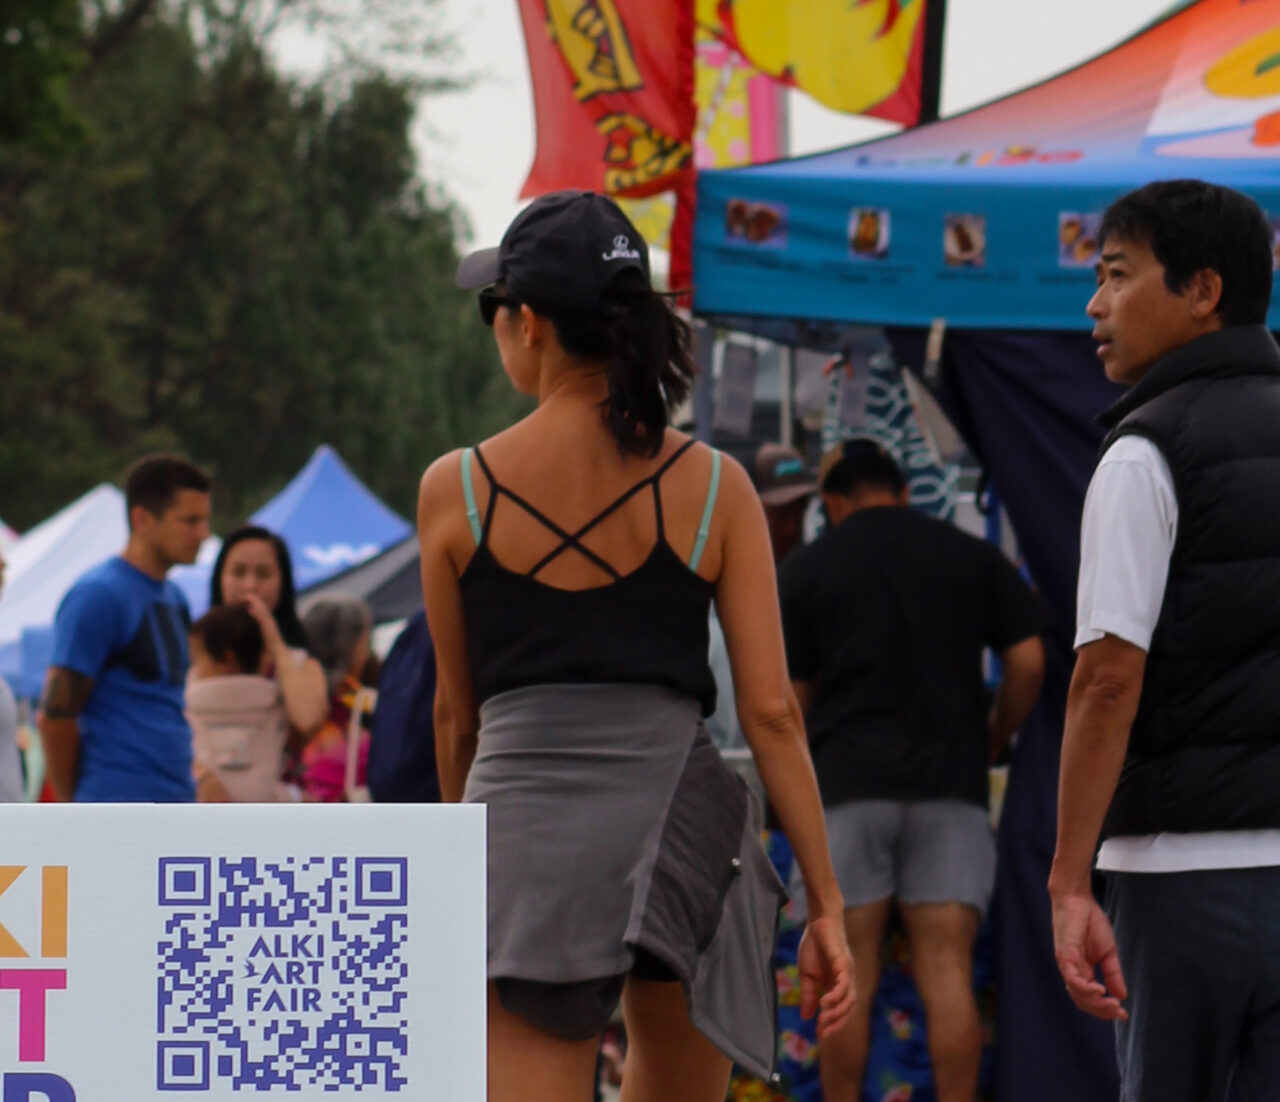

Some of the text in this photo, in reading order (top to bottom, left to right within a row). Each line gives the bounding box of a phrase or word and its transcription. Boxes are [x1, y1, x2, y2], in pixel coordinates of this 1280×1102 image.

[248, 934, 324, 958] ALKI
[260, 961, 324, 985] ART
[247, 987, 323, 1012] FAIR
